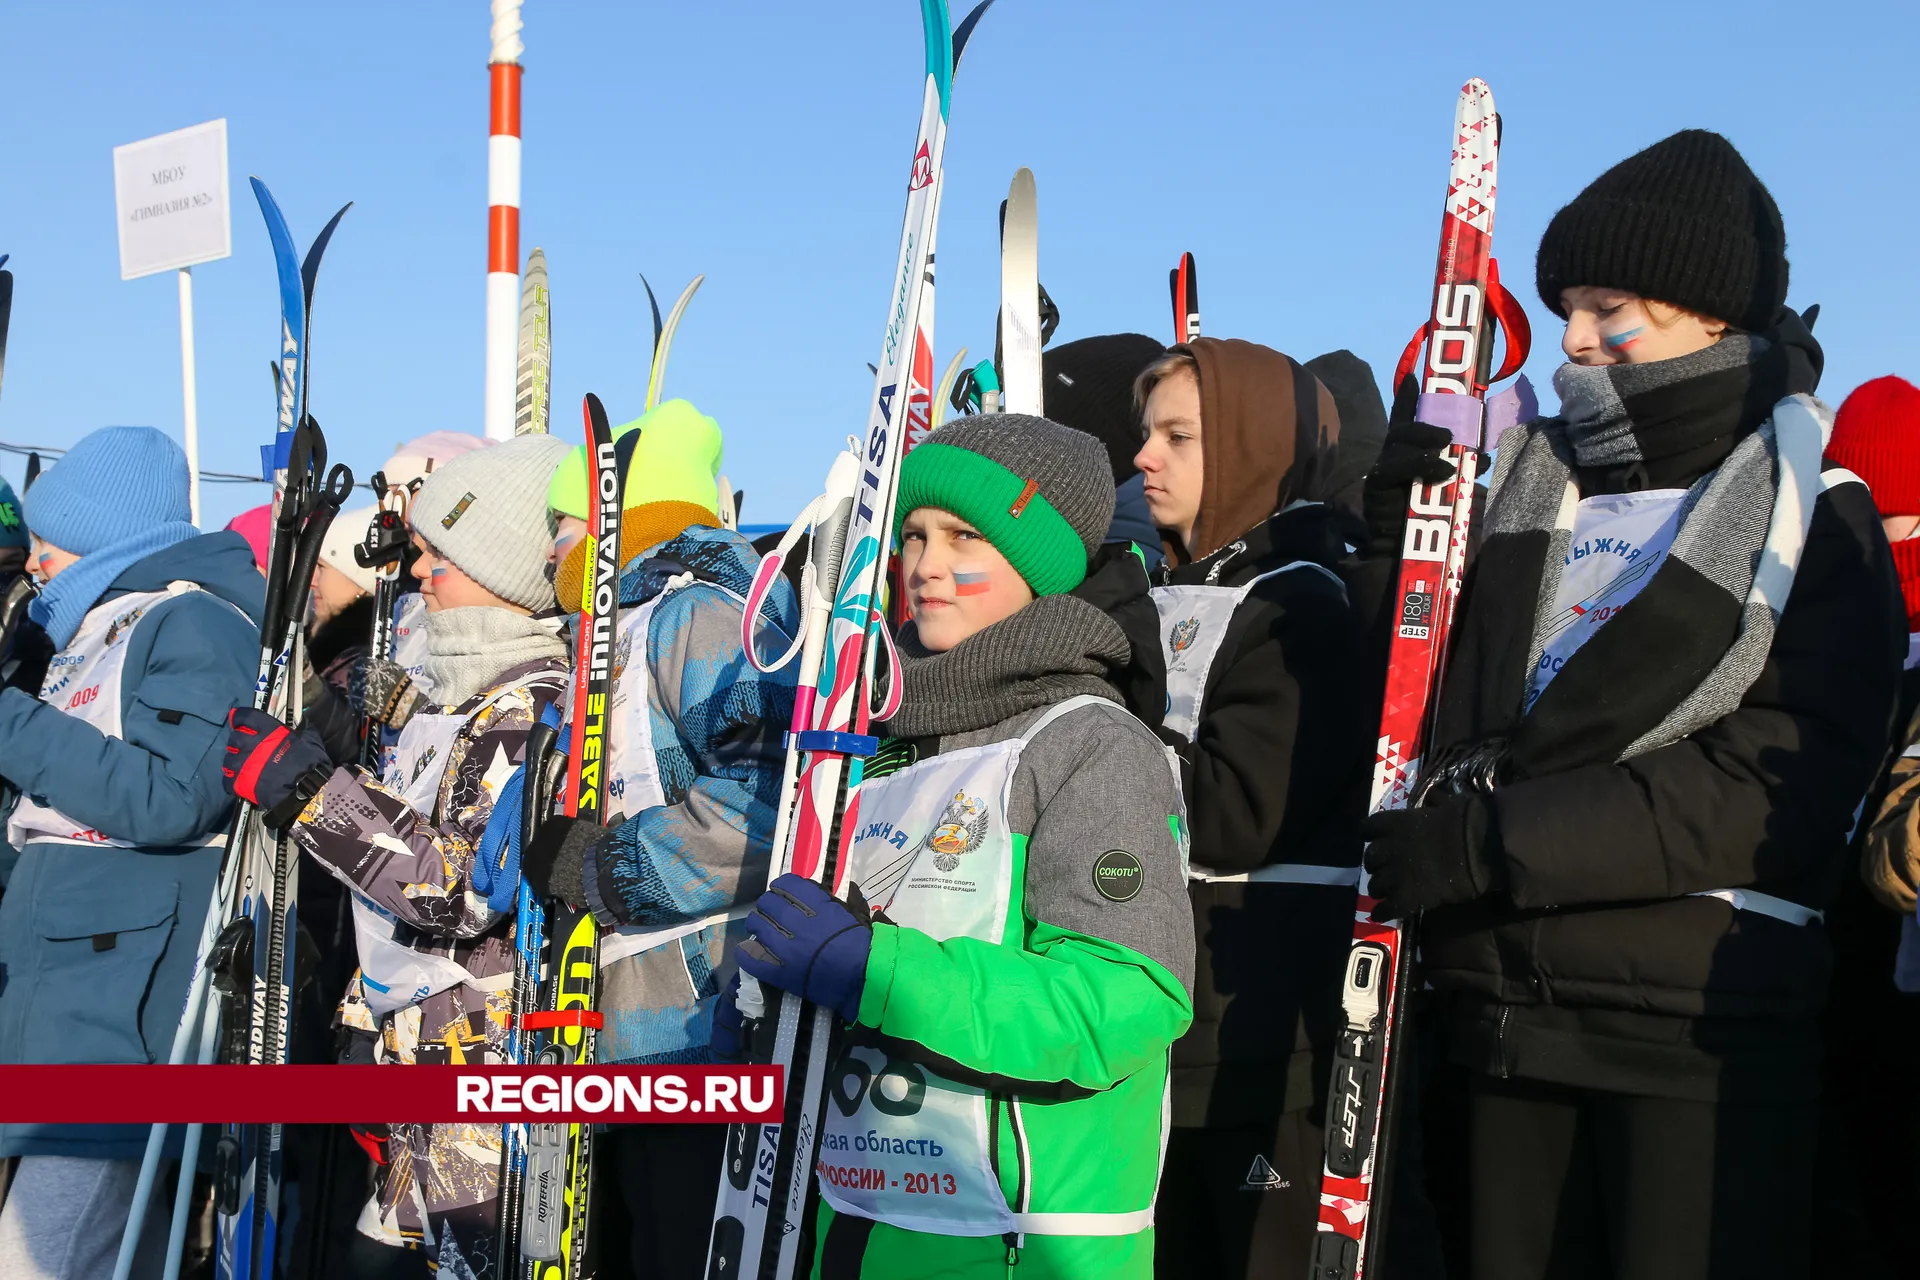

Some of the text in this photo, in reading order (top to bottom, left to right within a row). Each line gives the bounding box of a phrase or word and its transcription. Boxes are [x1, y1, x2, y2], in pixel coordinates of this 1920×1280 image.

[152, 165, 186, 186] МБОУ
[885, 232, 914, 366] Elegance
[279, 317, 298, 432] WAY
[855, 383, 897, 527] TISA
[371, 518, 379, 548] LEKI
[587, 541, 596, 610] TECHNOLOGY
[1403, 593, 1424, 623] 180
[1422, 595, 1432, 613] TOUR
[583, 619, 591, 656] SPORT
[1401, 627, 1428, 637] STEP
[579, 692, 606, 810] SABLE
[911, 876, 976, 887] МИНИСТЕРСТВО СПОРТА
[943, 885, 977, 893] ФЕДЕРАЦИИ
[854, 1129, 944, 1157] область
[752, 1125, 781, 1209] TISA
[791, 1113, 813, 1212] Elegance
[903, 1172, 957, 1196] 2013
